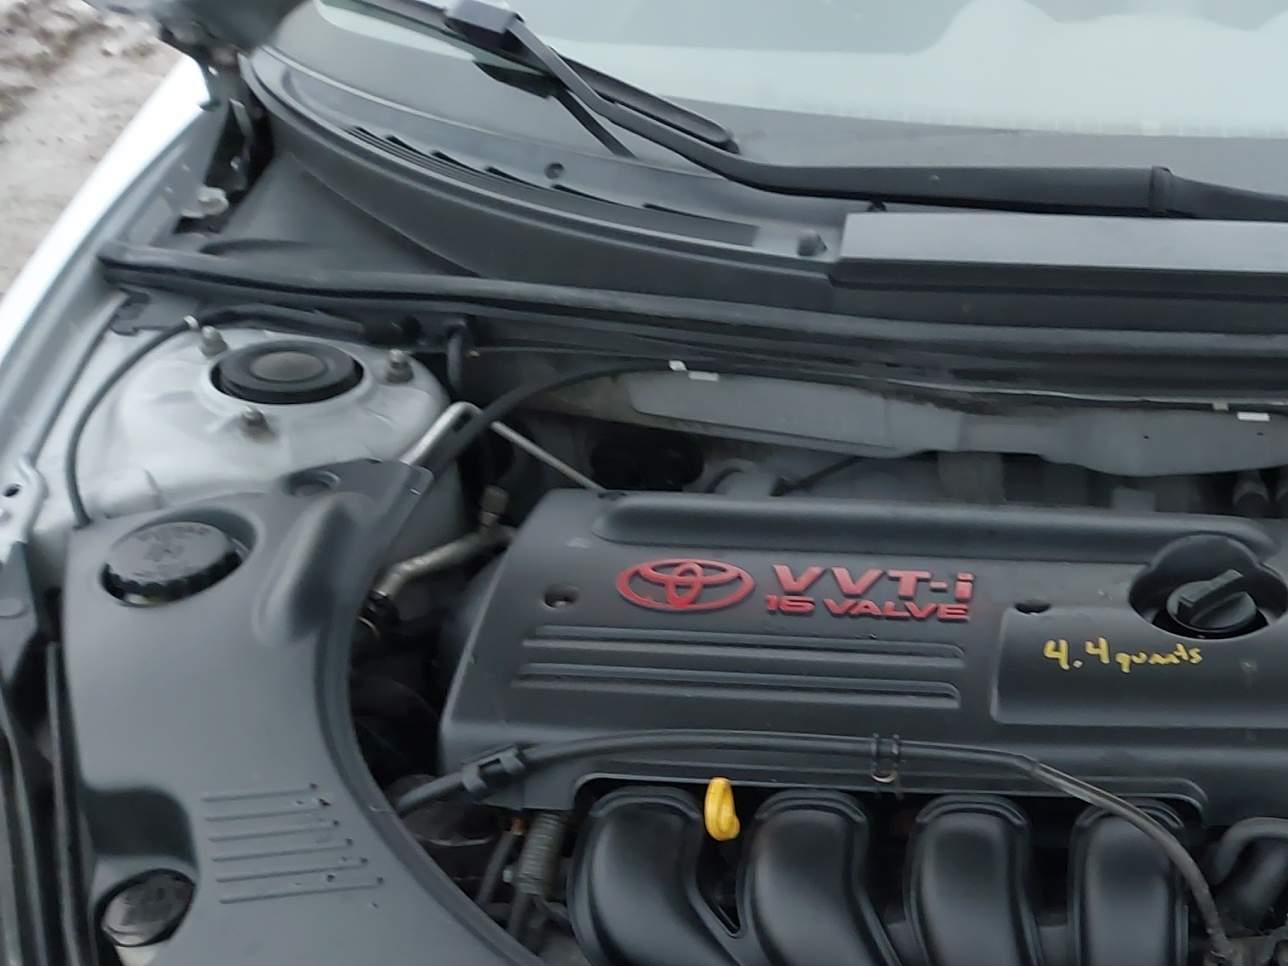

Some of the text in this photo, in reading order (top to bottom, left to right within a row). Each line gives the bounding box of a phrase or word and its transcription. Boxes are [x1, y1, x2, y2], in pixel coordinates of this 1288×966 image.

[771, 563, 976, 604] VVT-i
[767, 595, 971, 622] 16 VALVE
[1043, 637, 1111, 670] 4.4
